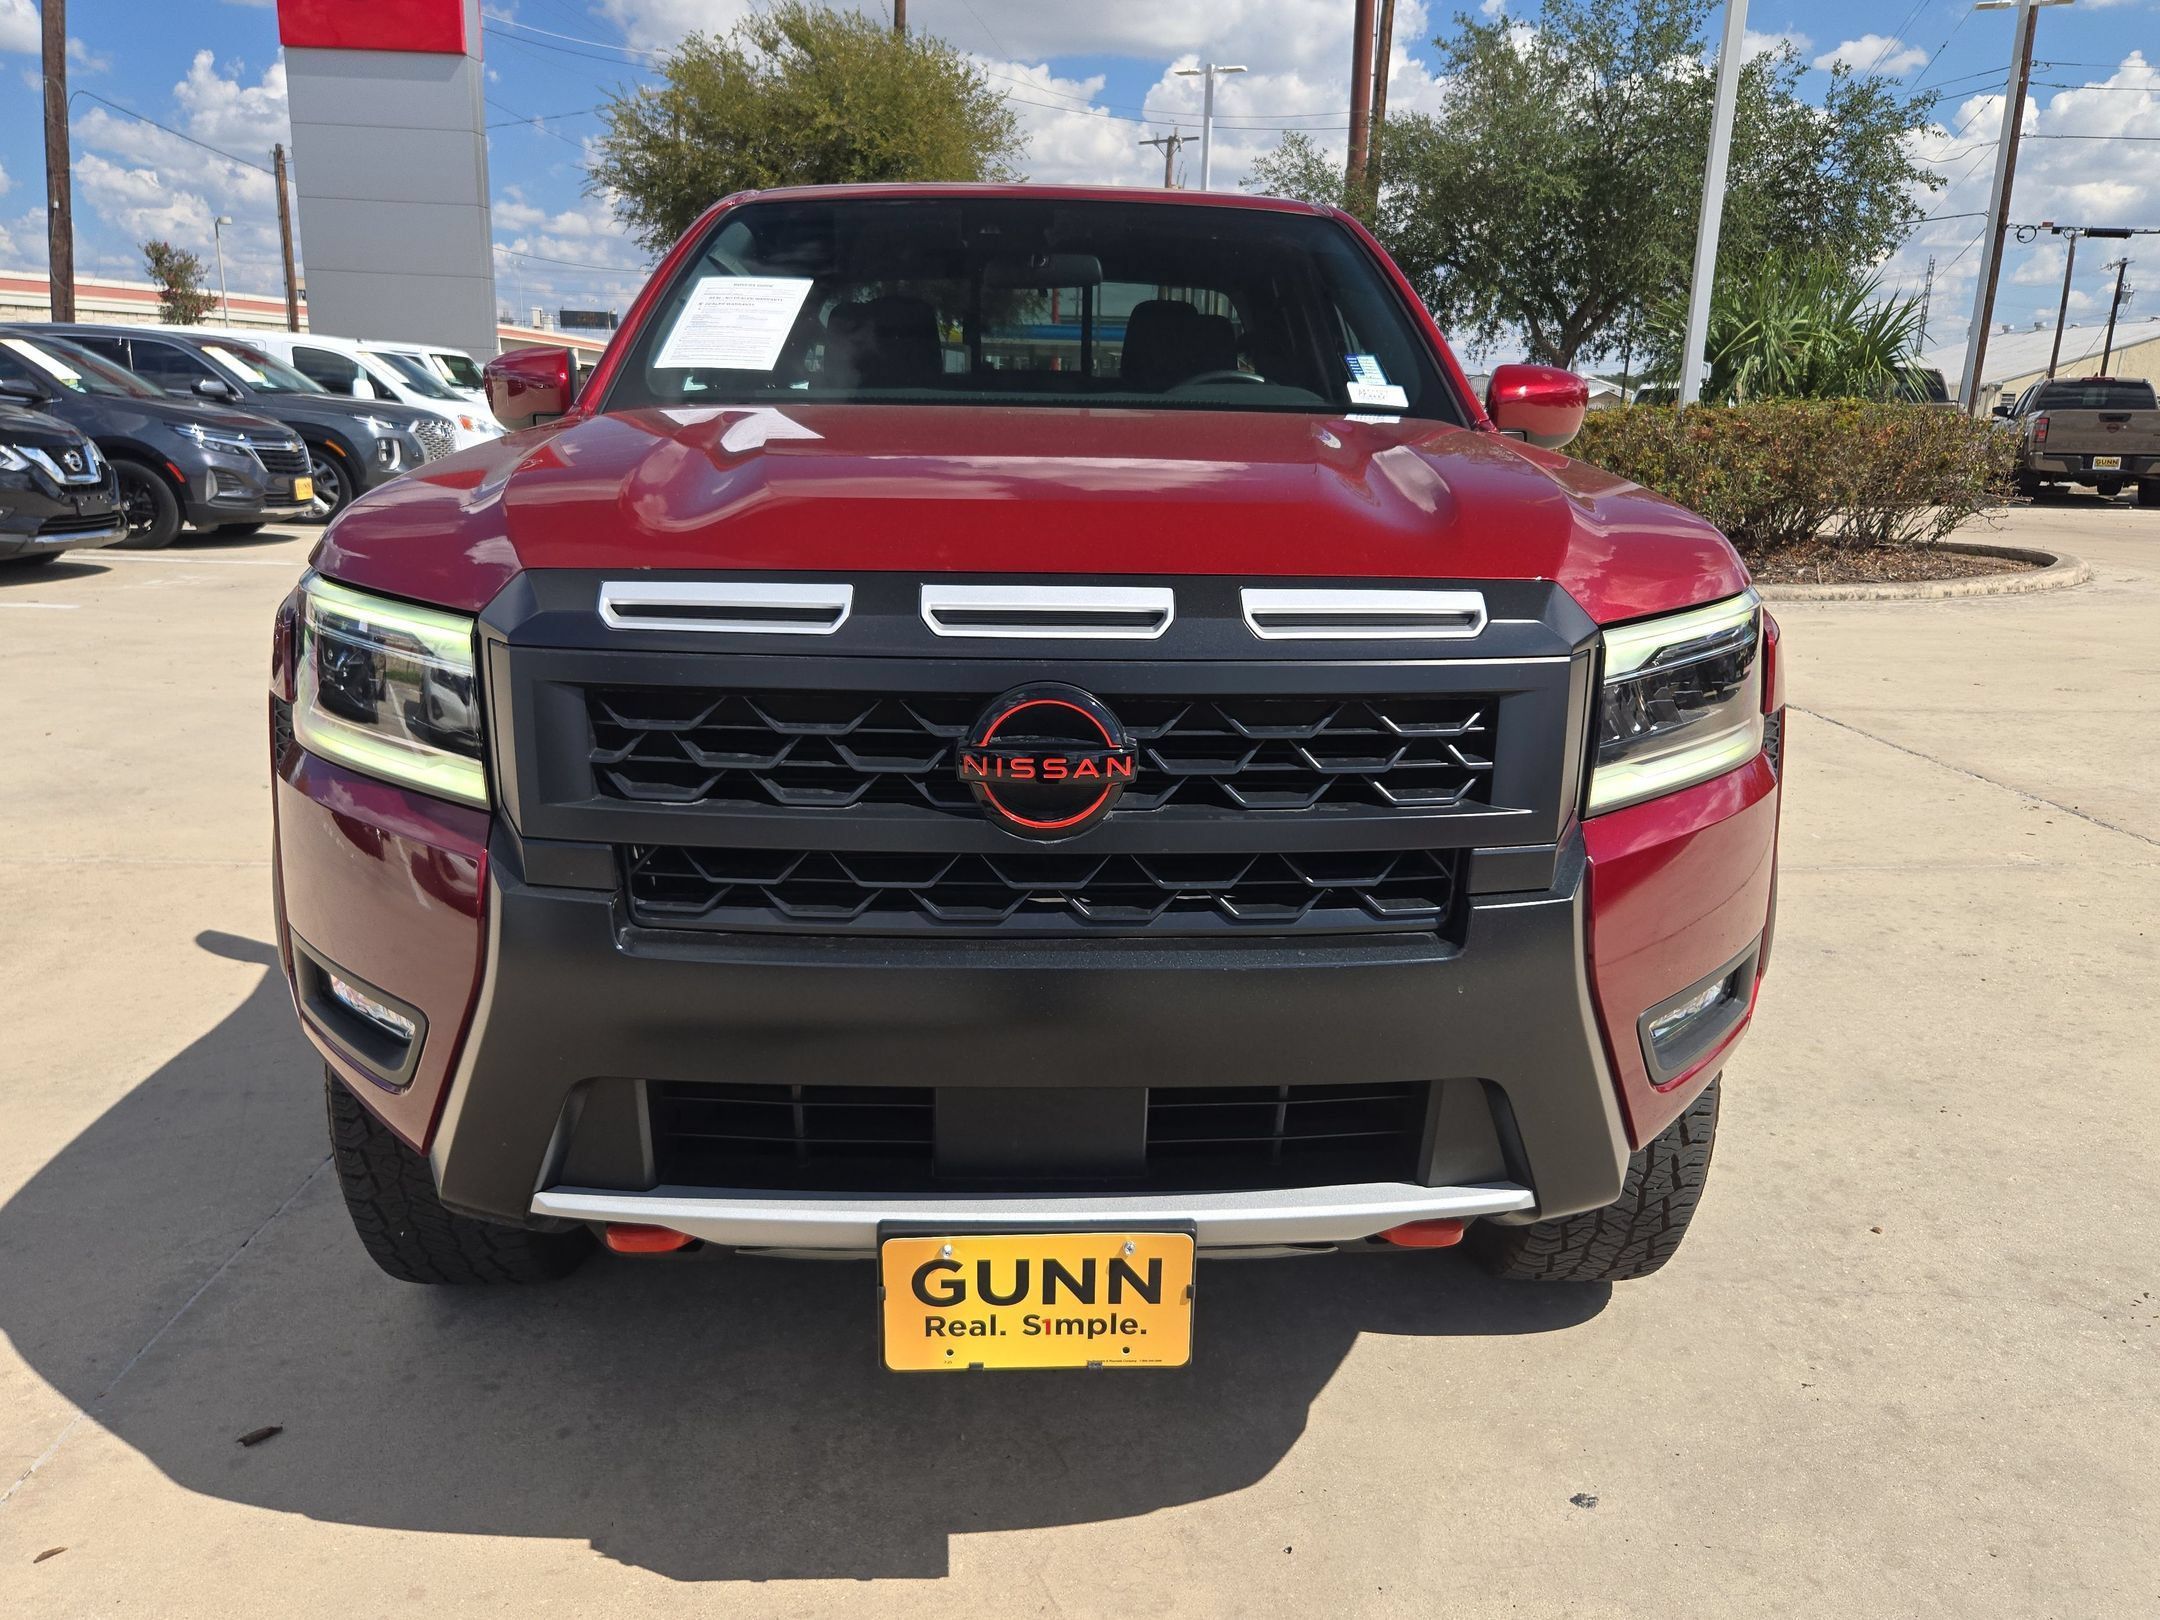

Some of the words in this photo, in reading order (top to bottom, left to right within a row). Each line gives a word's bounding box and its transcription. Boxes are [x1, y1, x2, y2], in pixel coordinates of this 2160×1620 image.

[962, 755, 1132, 779] NISSAN
[911, 1257, 1163, 1308] GUNN
[925, 1314, 1007, 1338] Real.
